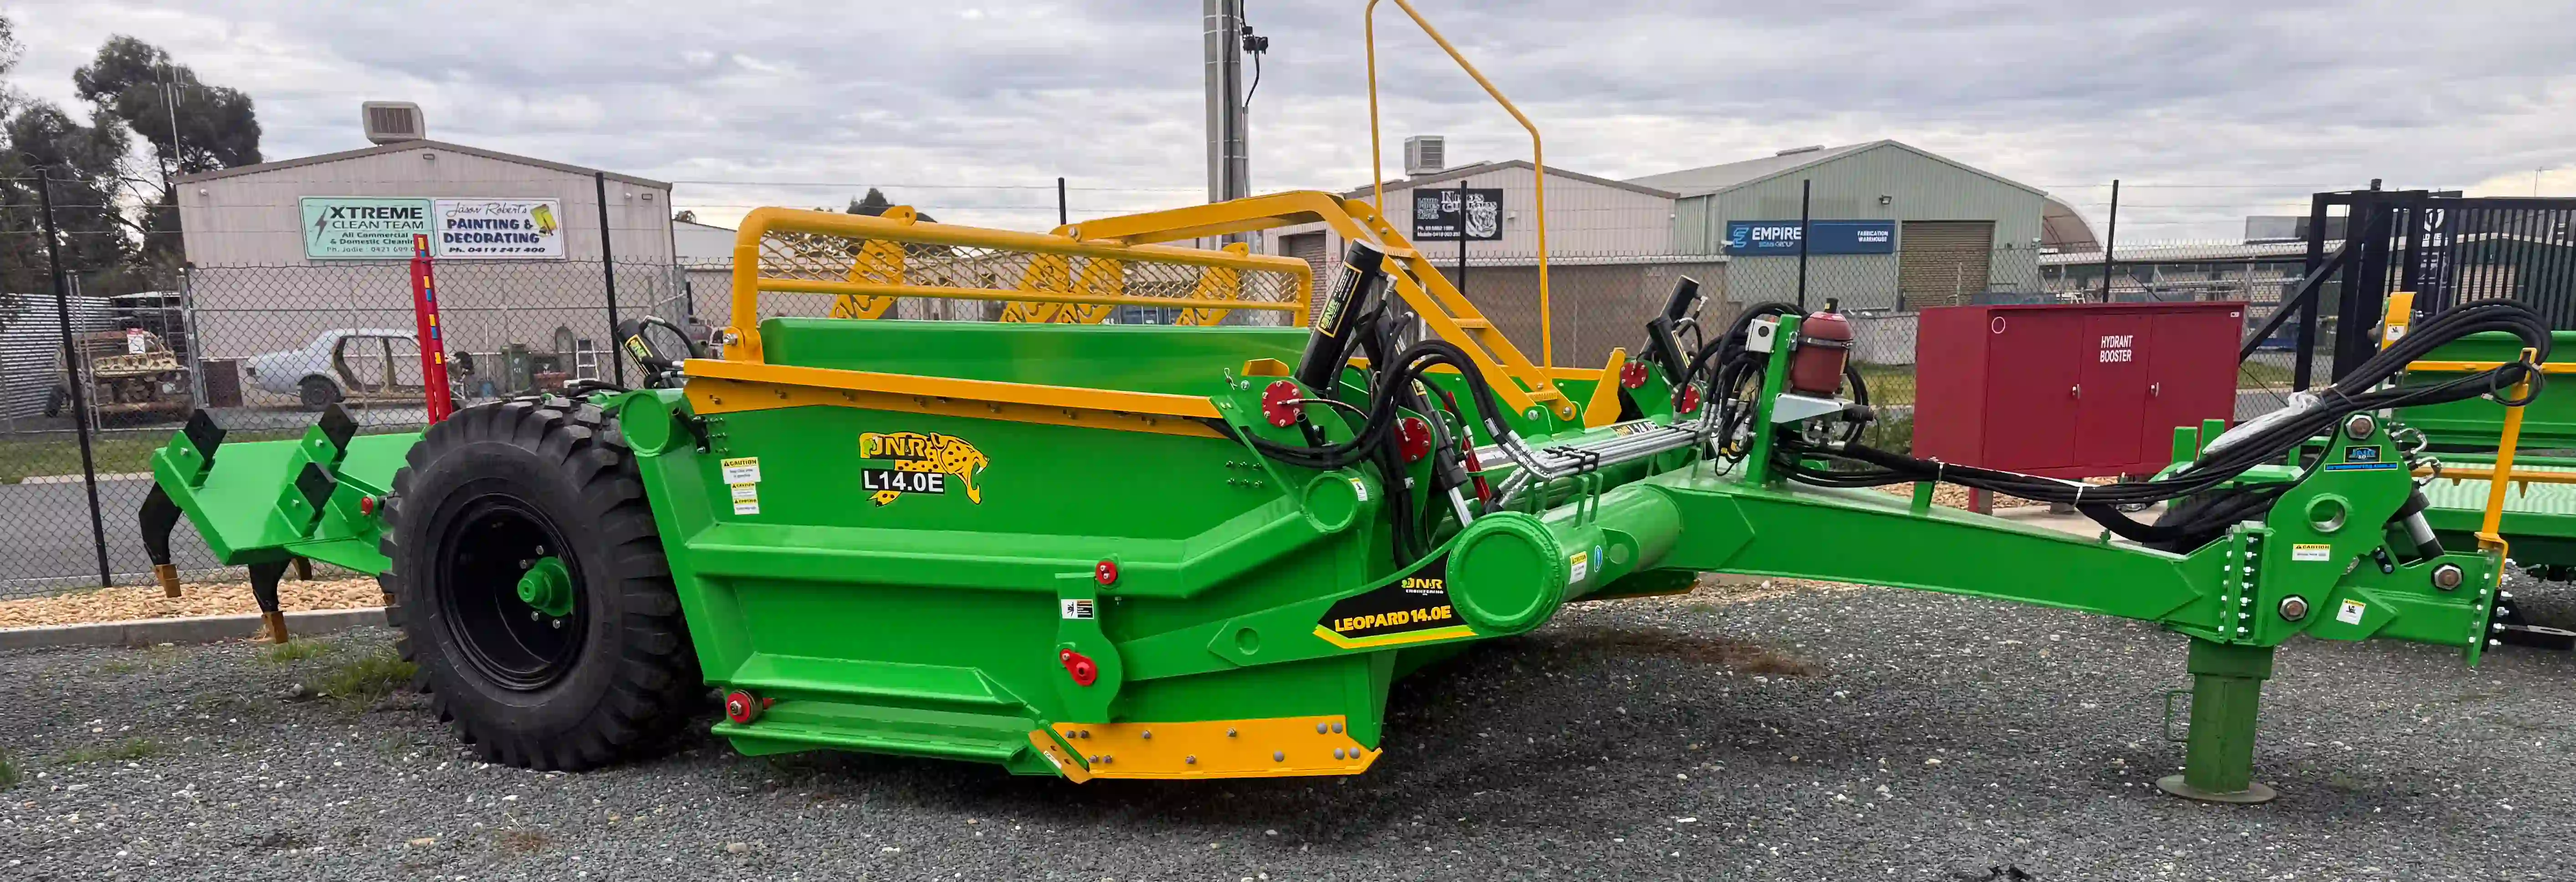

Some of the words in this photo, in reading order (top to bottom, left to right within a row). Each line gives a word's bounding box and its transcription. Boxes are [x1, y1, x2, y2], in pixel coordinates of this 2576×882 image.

[330, 207, 423, 219] XTREME
[332, 220, 379, 229] CLEAN
[383, 221, 424, 229] TEAM
[447, 219, 520, 229] PAINTING
[524, 219, 533, 229] &
[443, 233, 539, 244] DECORATING
[1752, 227, 1802, 240] EMPIRE
[2101, 335, 2134, 348] HYDRANT
[2100, 349, 2132, 362] BOOSTER
[864, 470, 944, 492] L14.0E
[1335, 611, 1409, 632] LEOPARD
[1411, 605, 1451, 622] 14.0E
